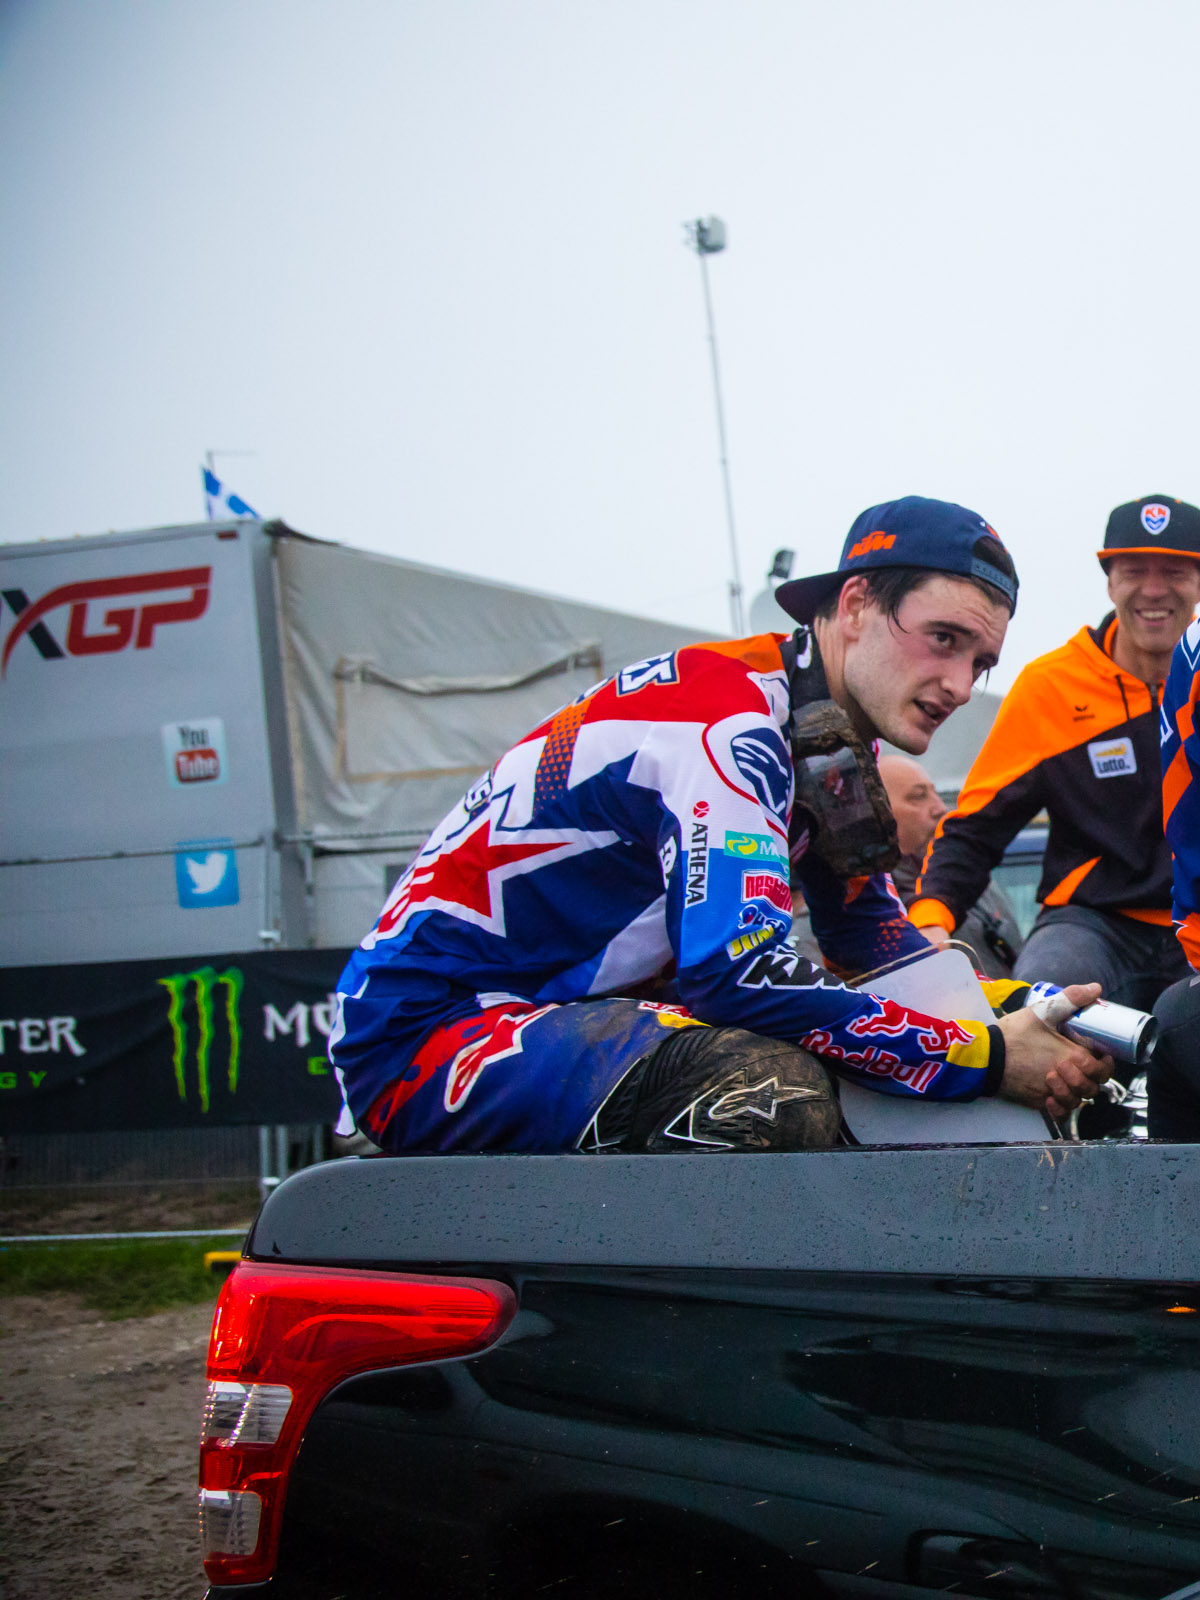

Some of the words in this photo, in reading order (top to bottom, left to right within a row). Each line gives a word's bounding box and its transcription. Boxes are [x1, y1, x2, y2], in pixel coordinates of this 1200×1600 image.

[847, 531, 897, 559] KTM
[178, 727, 209, 746] You
[178, 754, 219, 779] Tube
[1097, 759, 1125, 774] Lotto
[686, 822, 708, 905] ATHENA
